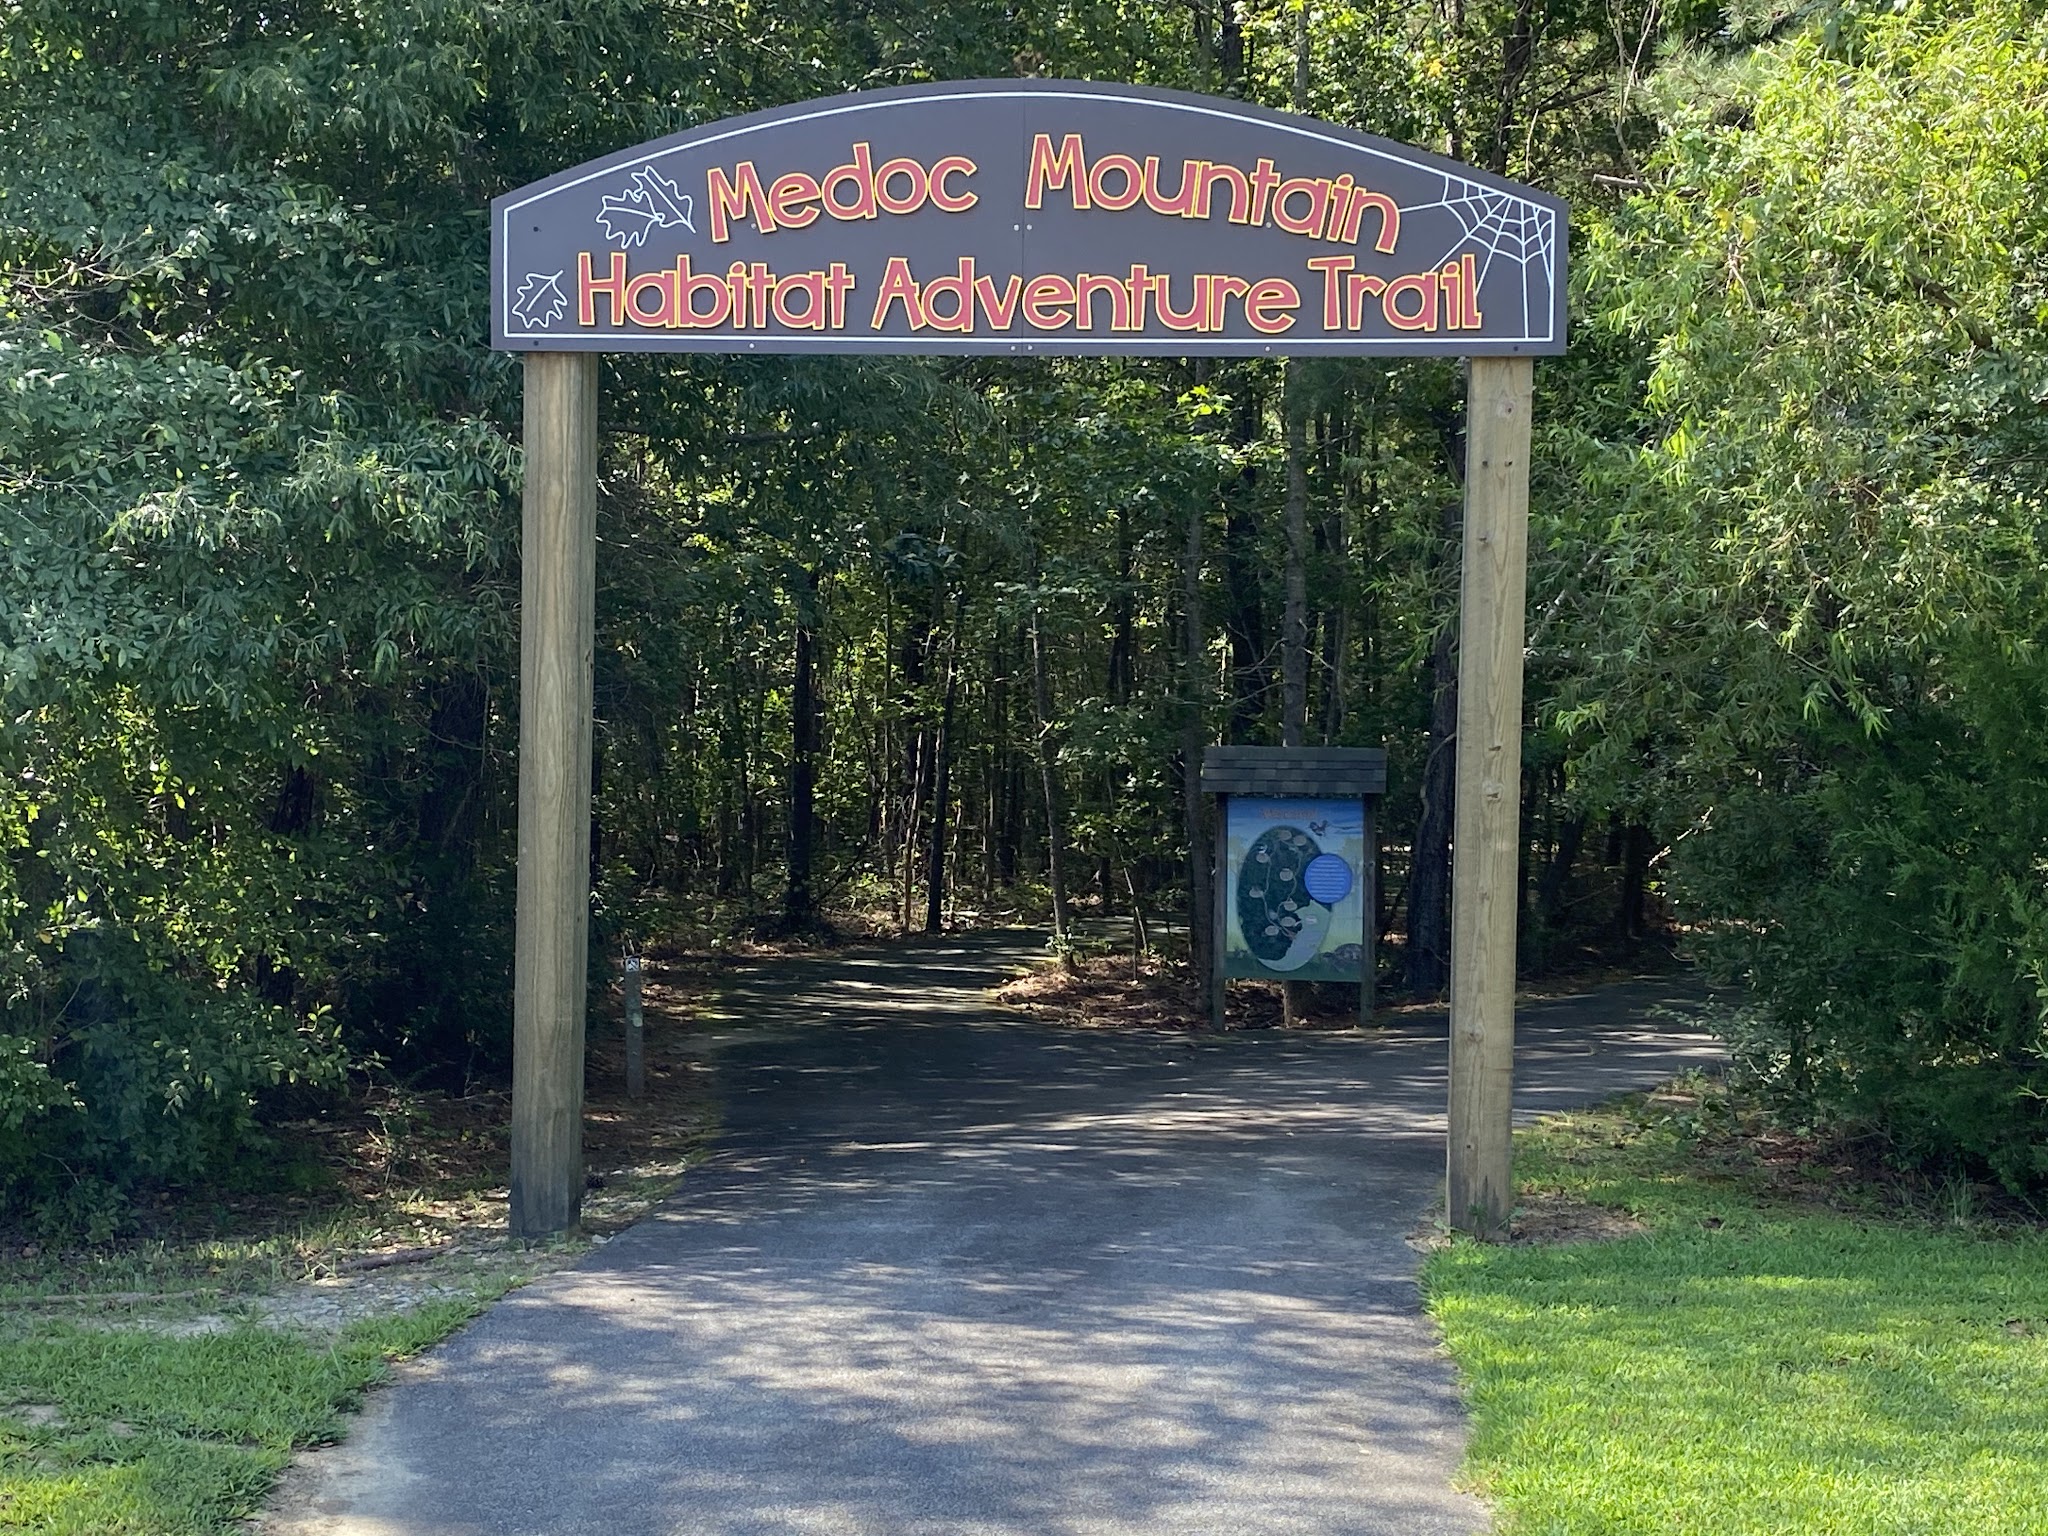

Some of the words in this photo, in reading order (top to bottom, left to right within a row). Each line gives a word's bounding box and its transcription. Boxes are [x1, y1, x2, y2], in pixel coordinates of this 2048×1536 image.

[706, 141, 978, 243] Medoc
[1024, 133, 1401, 255] Mountain
[577, 251, 855, 330] Habitat
[870, 256, 1301, 334] Adventure
[1307, 253, 1483, 332] Trail
